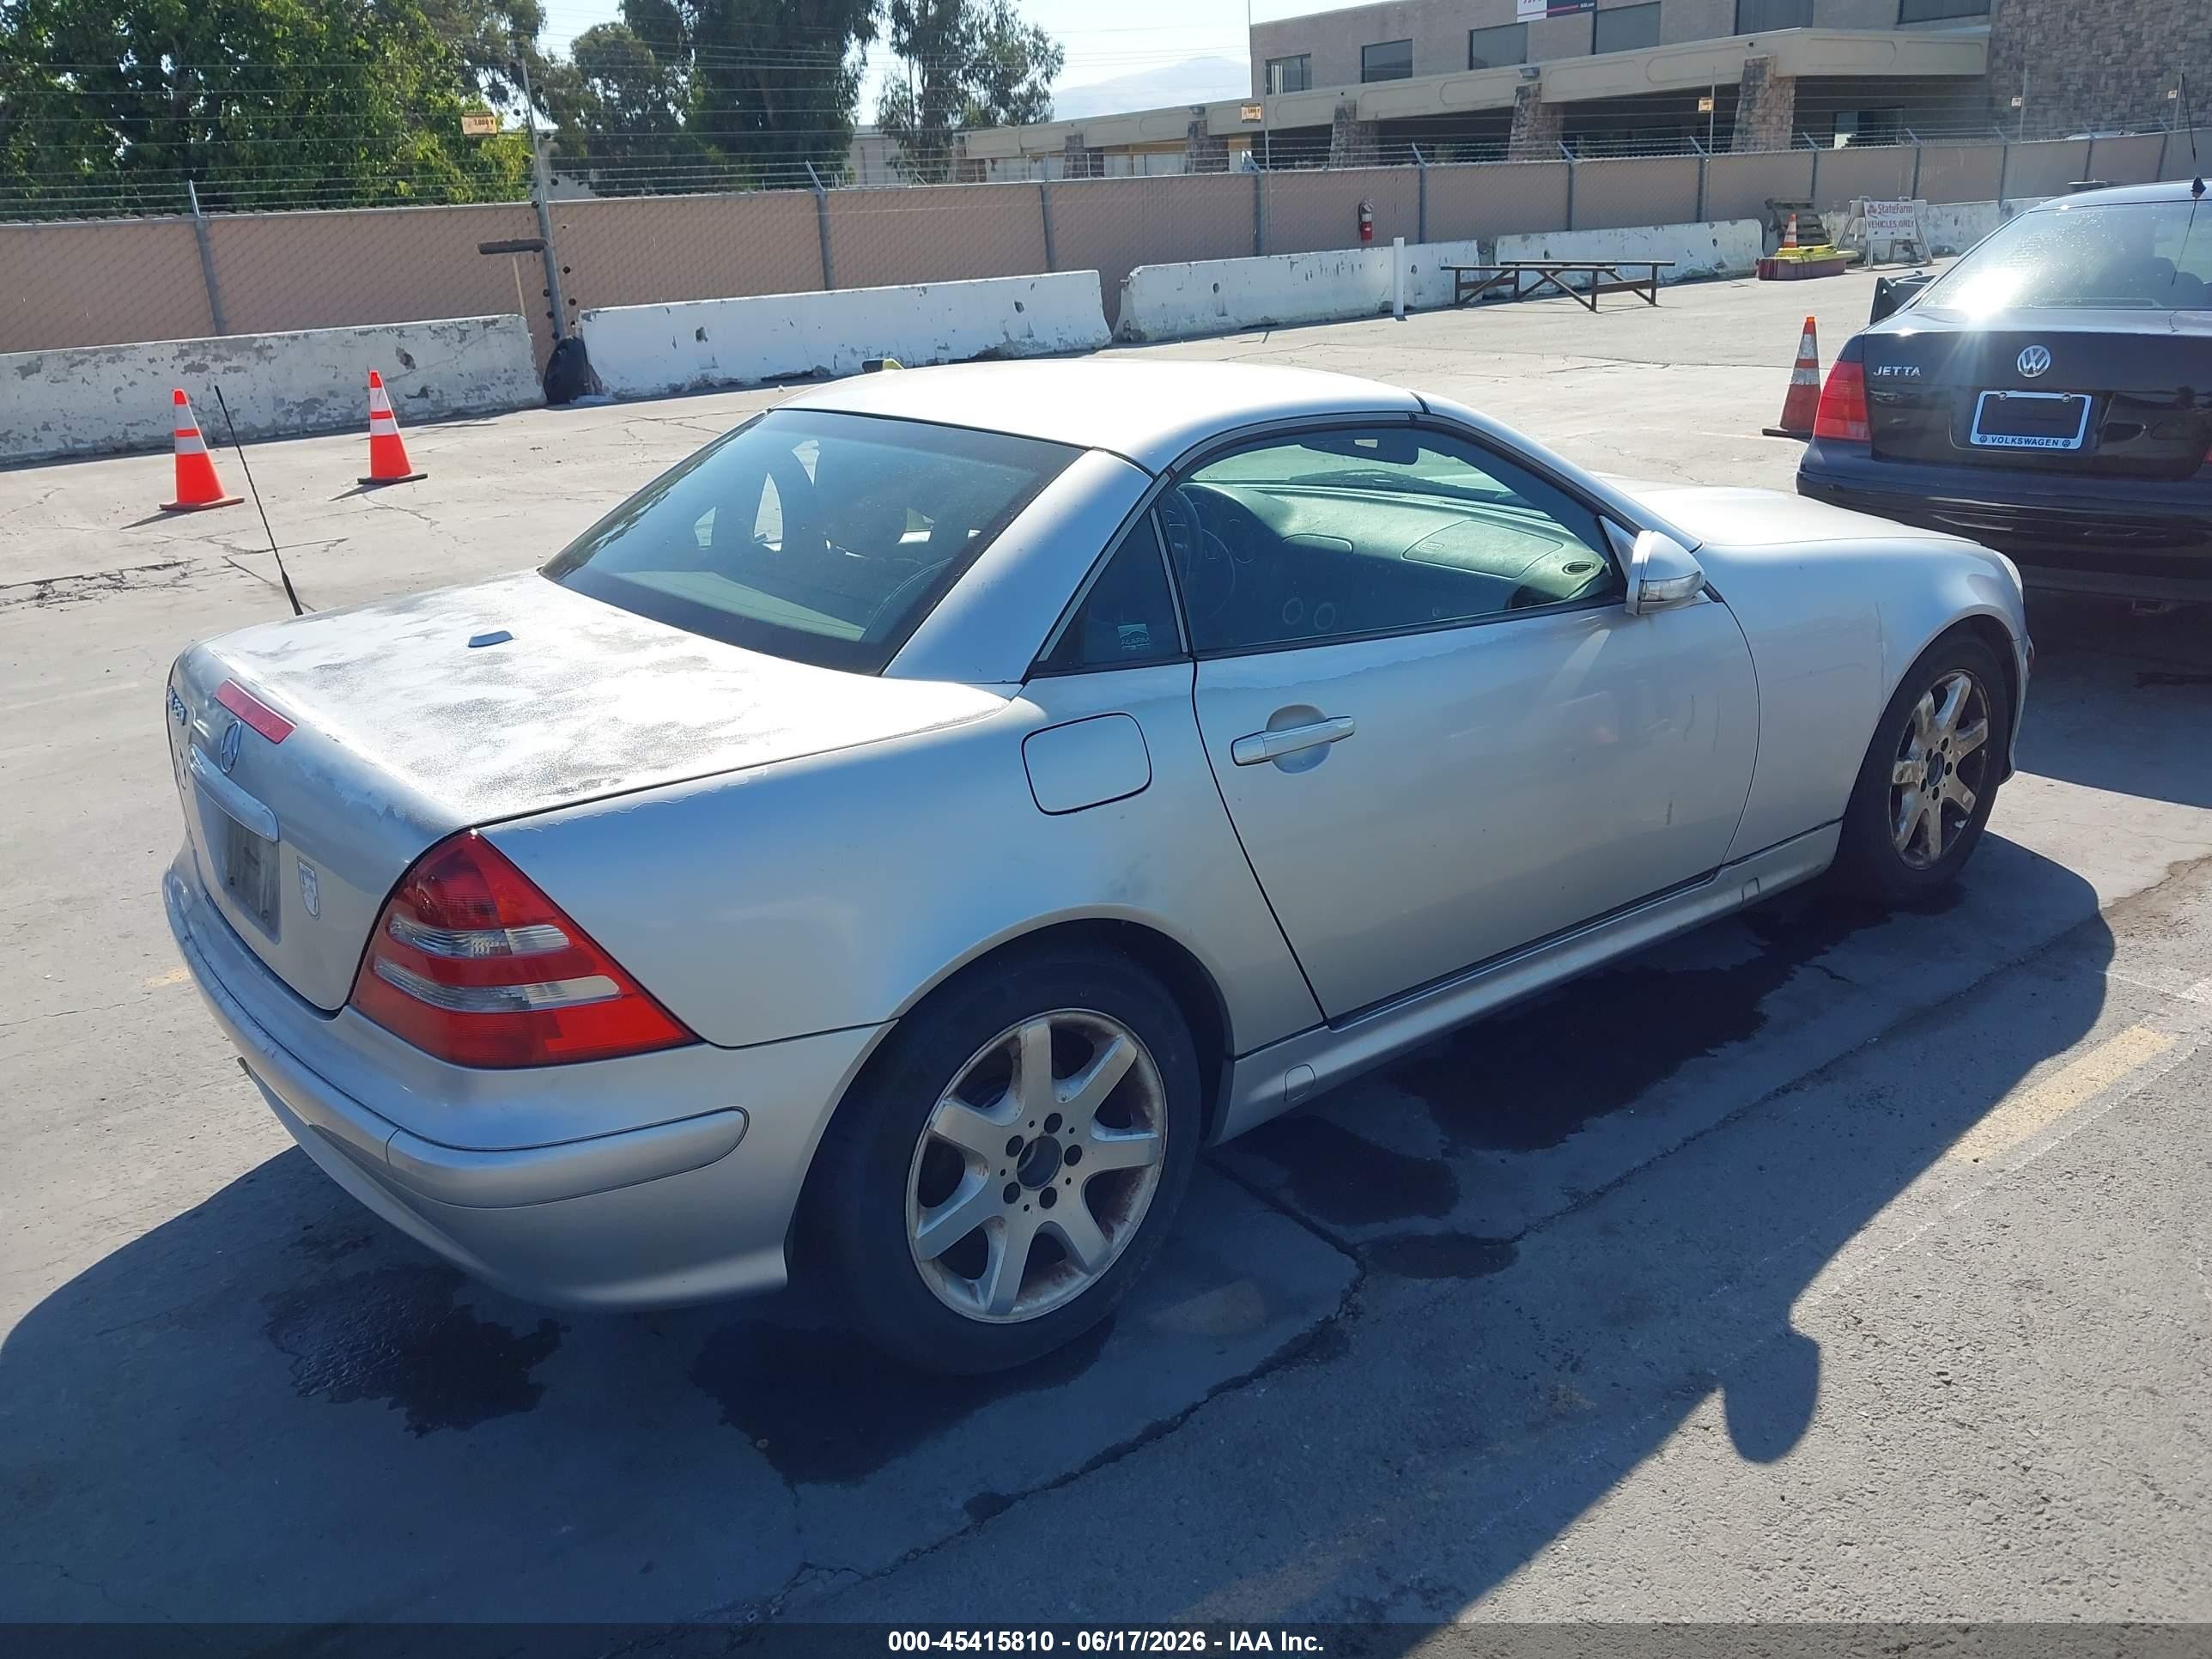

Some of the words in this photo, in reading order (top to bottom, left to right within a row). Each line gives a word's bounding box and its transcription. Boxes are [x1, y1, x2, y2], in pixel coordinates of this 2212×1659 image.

[1868, 220, 1897, 228] VEHICLES
[1899, 219, 1914, 228] ONLY
[1873, 366, 1922, 377] JETTA
[1991, 435, 2059, 447] VOLKSWAGEN
